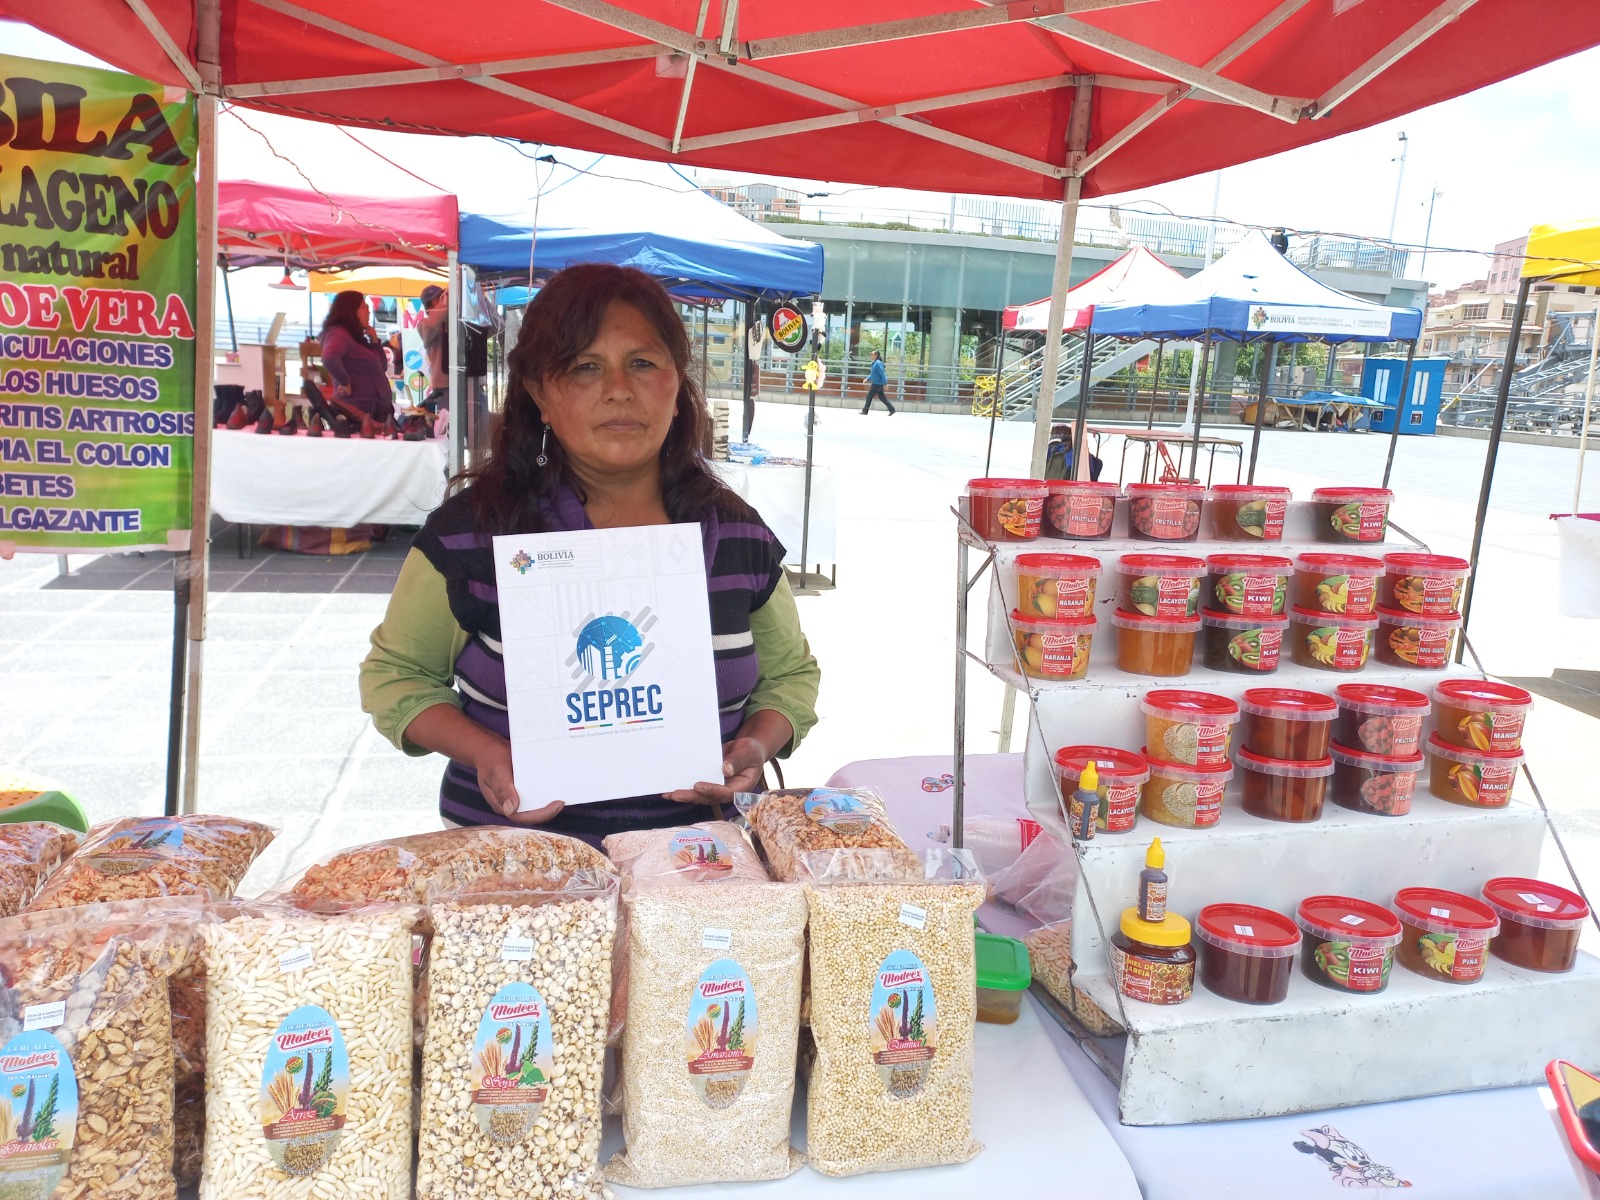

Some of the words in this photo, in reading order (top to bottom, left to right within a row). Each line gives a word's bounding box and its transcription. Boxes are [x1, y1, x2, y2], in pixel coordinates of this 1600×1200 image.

[1, 241, 139, 280] natural
[62, 288, 195, 338] VERA
[1270, 316, 1295, 324] BOLIVIA
[779, 319, 800, 337] BOLIVIA
[46, 372, 158, 399] HUESOS
[67, 408, 194, 435] ARTROSIS
[0, 438, 31, 462] IA
[36, 440, 71, 464] EL
[76, 442, 169, 467] COLON
[1155, 518, 1182, 526] FRUTILLA
[537, 551, 574, 561] BOLIVIA
[566, 684, 663, 723] SEPREC
[1482, 783, 1508, 791] MANGO
[1126, 958, 1141, 968] MIEL
[1144, 963, 1155, 971] DE
[1462, 957, 1478, 965] PIÑA
[881, 971, 923, 987] Modeex
[1128, 966, 1150, 977] ABEJA
[700, 980, 744, 997] Modeex
[491, 1003, 540, 1020] Modeex
[277, 1027, 332, 1050] Modeex
[8, 1043, 55, 1052] CEREALES
[699, 1049, 743, 1060] Amaranto
[0, 1051, 58, 1072] Modeex
[280, 1108, 317, 1123] Arroz
[0, 1136, 58, 1157] Granolas
